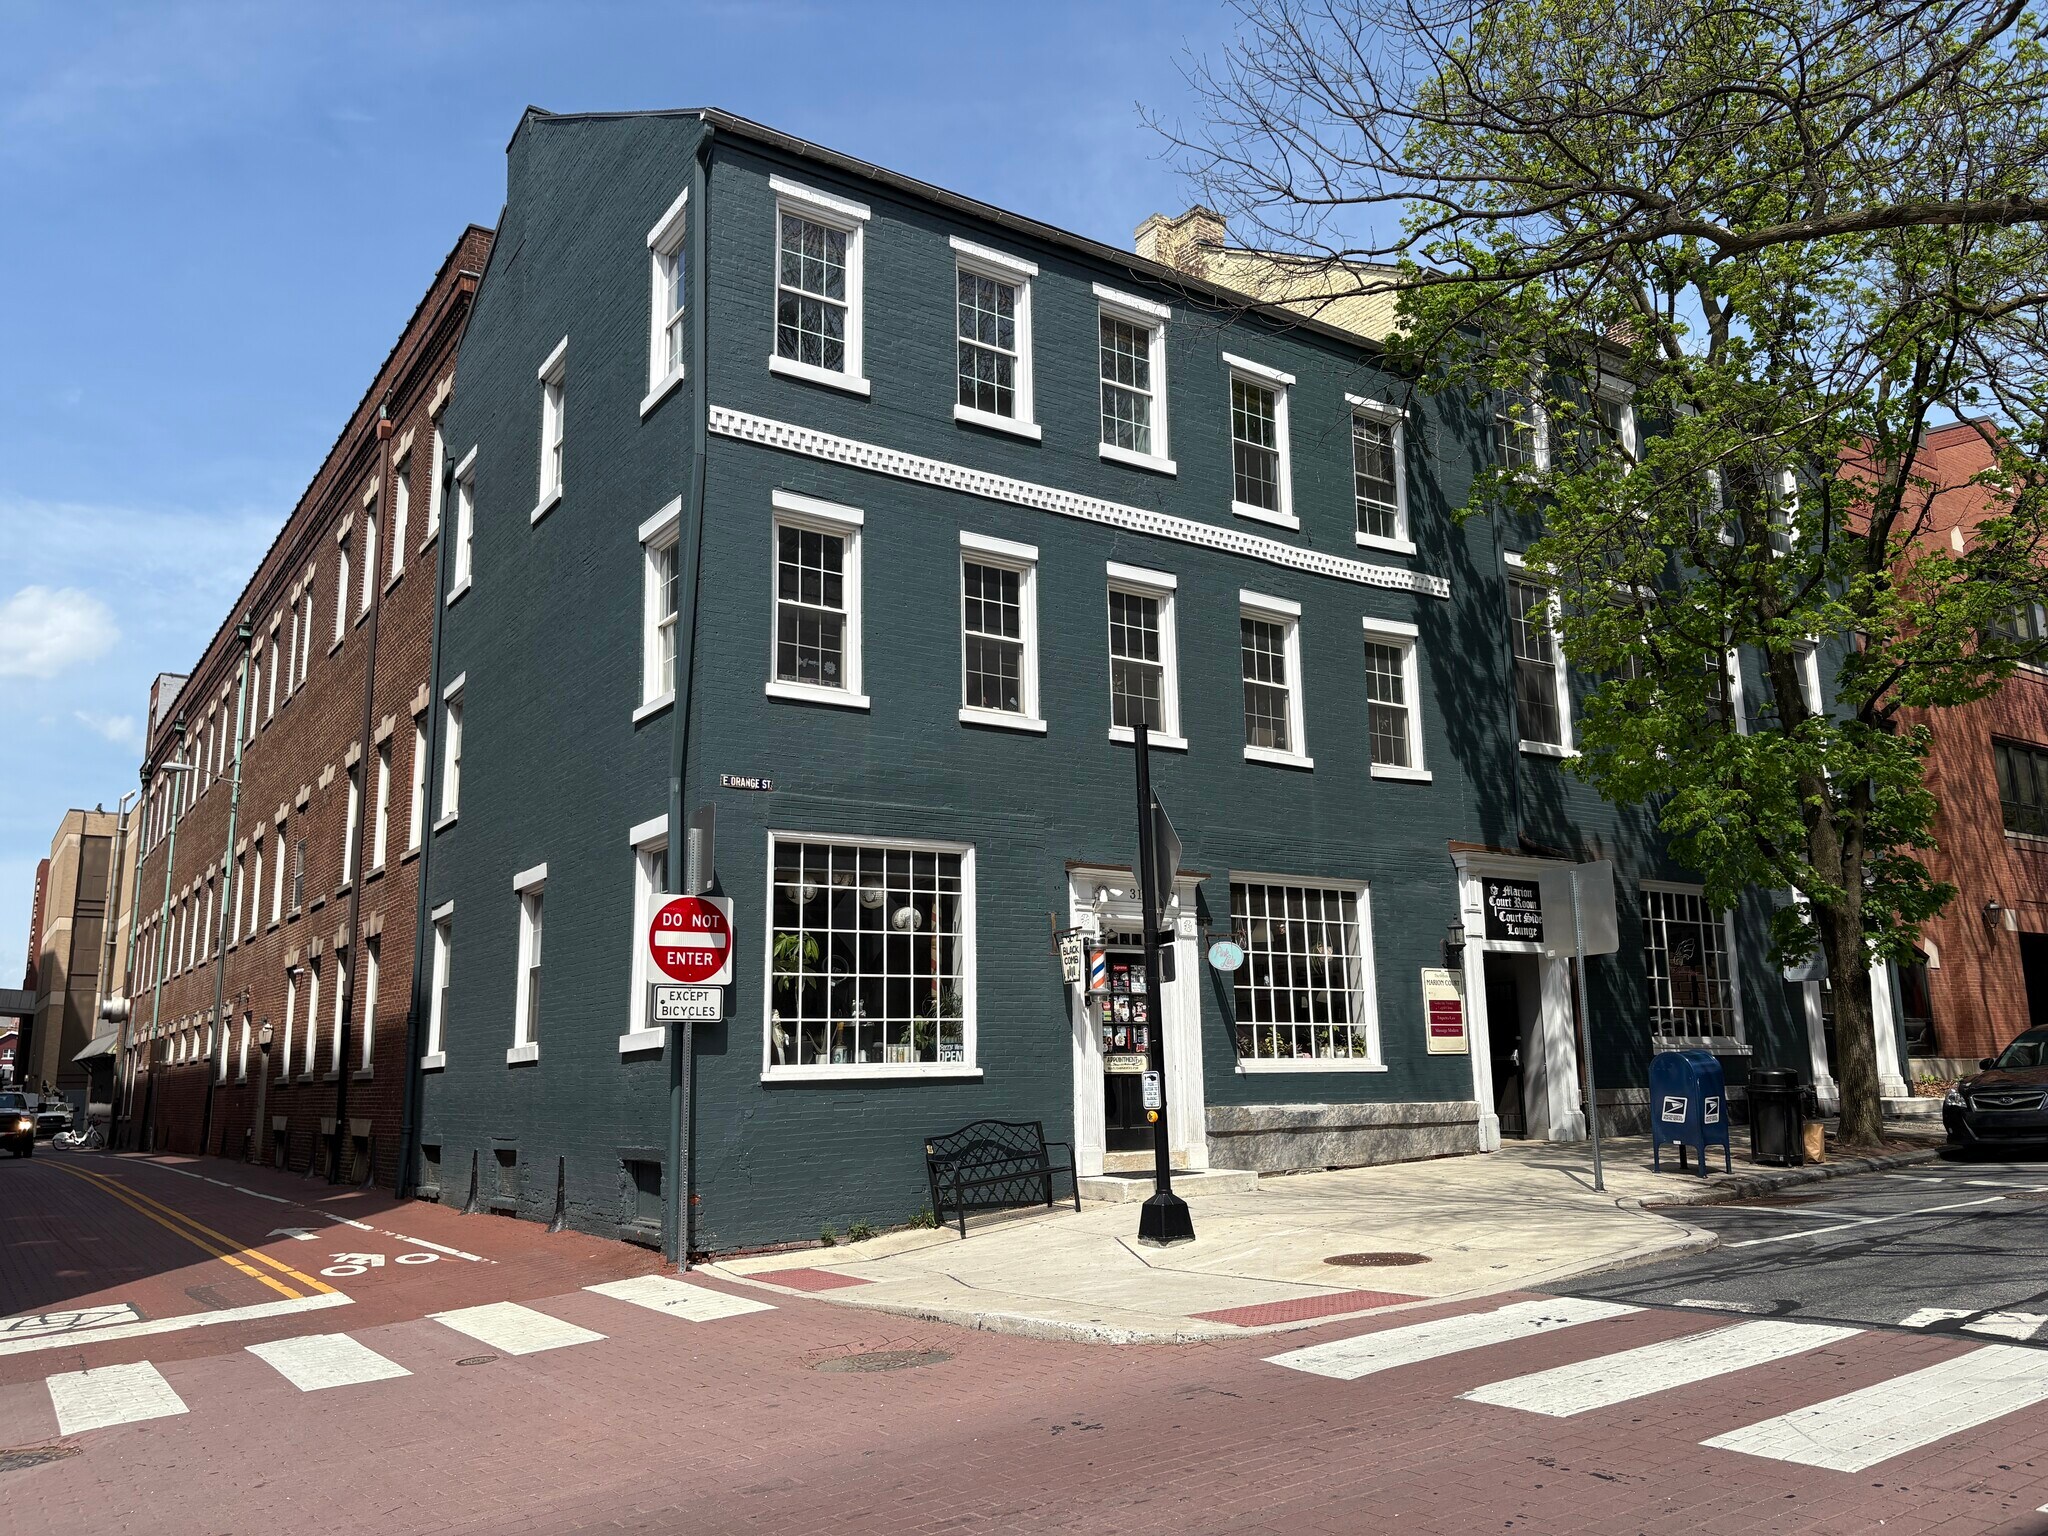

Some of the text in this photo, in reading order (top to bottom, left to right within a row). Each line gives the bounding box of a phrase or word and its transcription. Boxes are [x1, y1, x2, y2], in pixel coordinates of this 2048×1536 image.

[730, 776, 760, 789] ORANGE
[1502, 885, 1532, 898] Marion
[1489, 895, 1537, 909] Court Room
[662, 912, 720, 928] DO NOT
[1498, 910, 1543, 924] Court Side
[1506, 923, 1538, 938] Lounge
[1063, 945, 1080, 956] BLACK
[667, 951, 713, 966] ENTER
[1064, 955, 1079, 965] COMB
[1426, 979, 1445, 987] MARION
[669, 990, 709, 1002] EXCEPT
[662, 1006, 716, 1017] BICYCLES
[940, 1050, 963, 1062] OPEN
